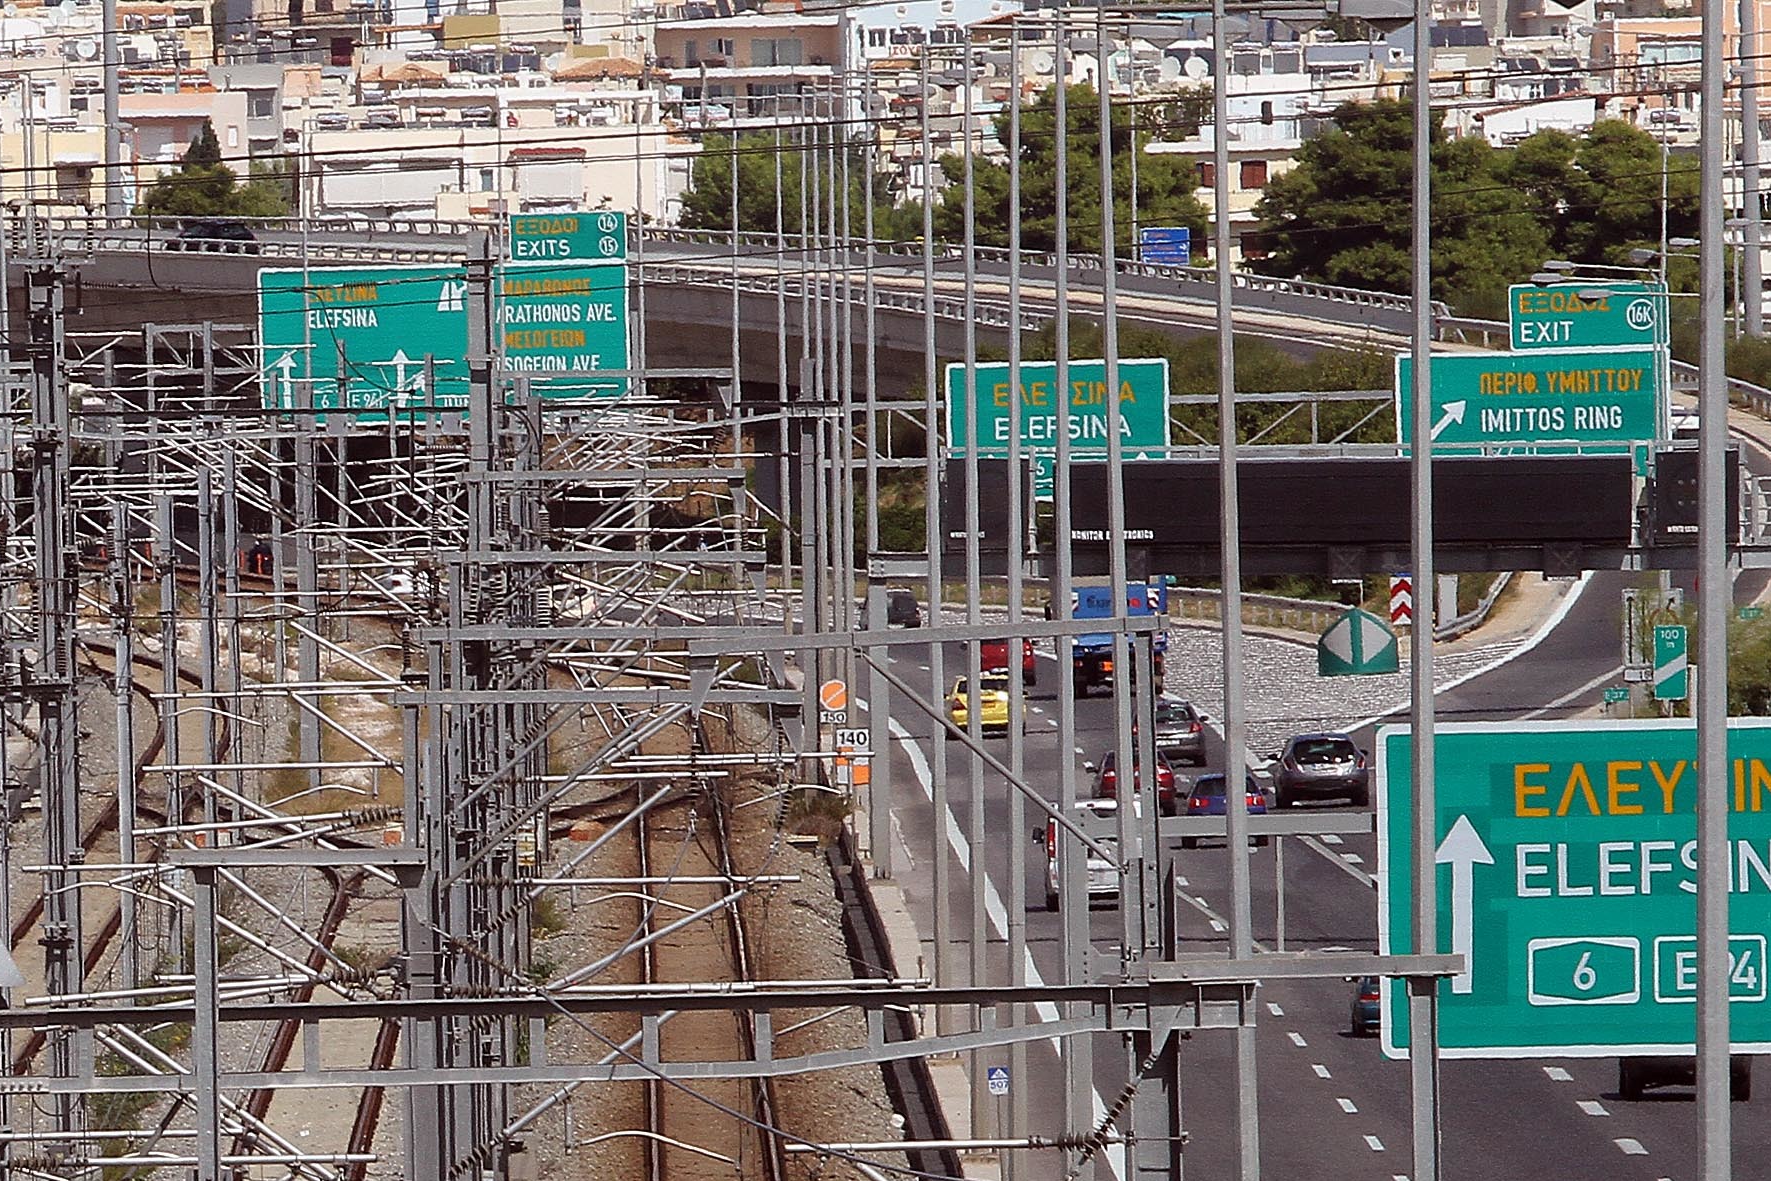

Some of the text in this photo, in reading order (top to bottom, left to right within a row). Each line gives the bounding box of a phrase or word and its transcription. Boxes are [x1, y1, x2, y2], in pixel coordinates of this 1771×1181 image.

[515, 218, 580, 235] ΕΞΟΔΟΙ
[602, 216, 614, 229] 14
[517, 240, 570, 256] EXITS
[603, 241, 614, 253] 15
[309, 309, 378, 329] ELEFSINA
[586, 303, 617, 322] AVE.
[1632, 306, 1652, 322] 16K
[1520, 321, 1574, 343] EXIT
[1480, 368, 1642, 395] ΠΕΡΙΦ. ΥΜΗΤΤΟΥ
[321, 394, 330, 408] 6
[993, 381, 1136, 406] ΕΛΕΣΙΝΑ
[1480, 405, 1623, 433] IMITTOS RING
[1036, 460, 1045, 476] 6
[1661, 630, 1679, 639] 100
[839, 731, 867, 746] 140
[1514, 759, 1771, 817] ΕΛΕΥΙΝ
[1573, 951, 1597, 991] 6
